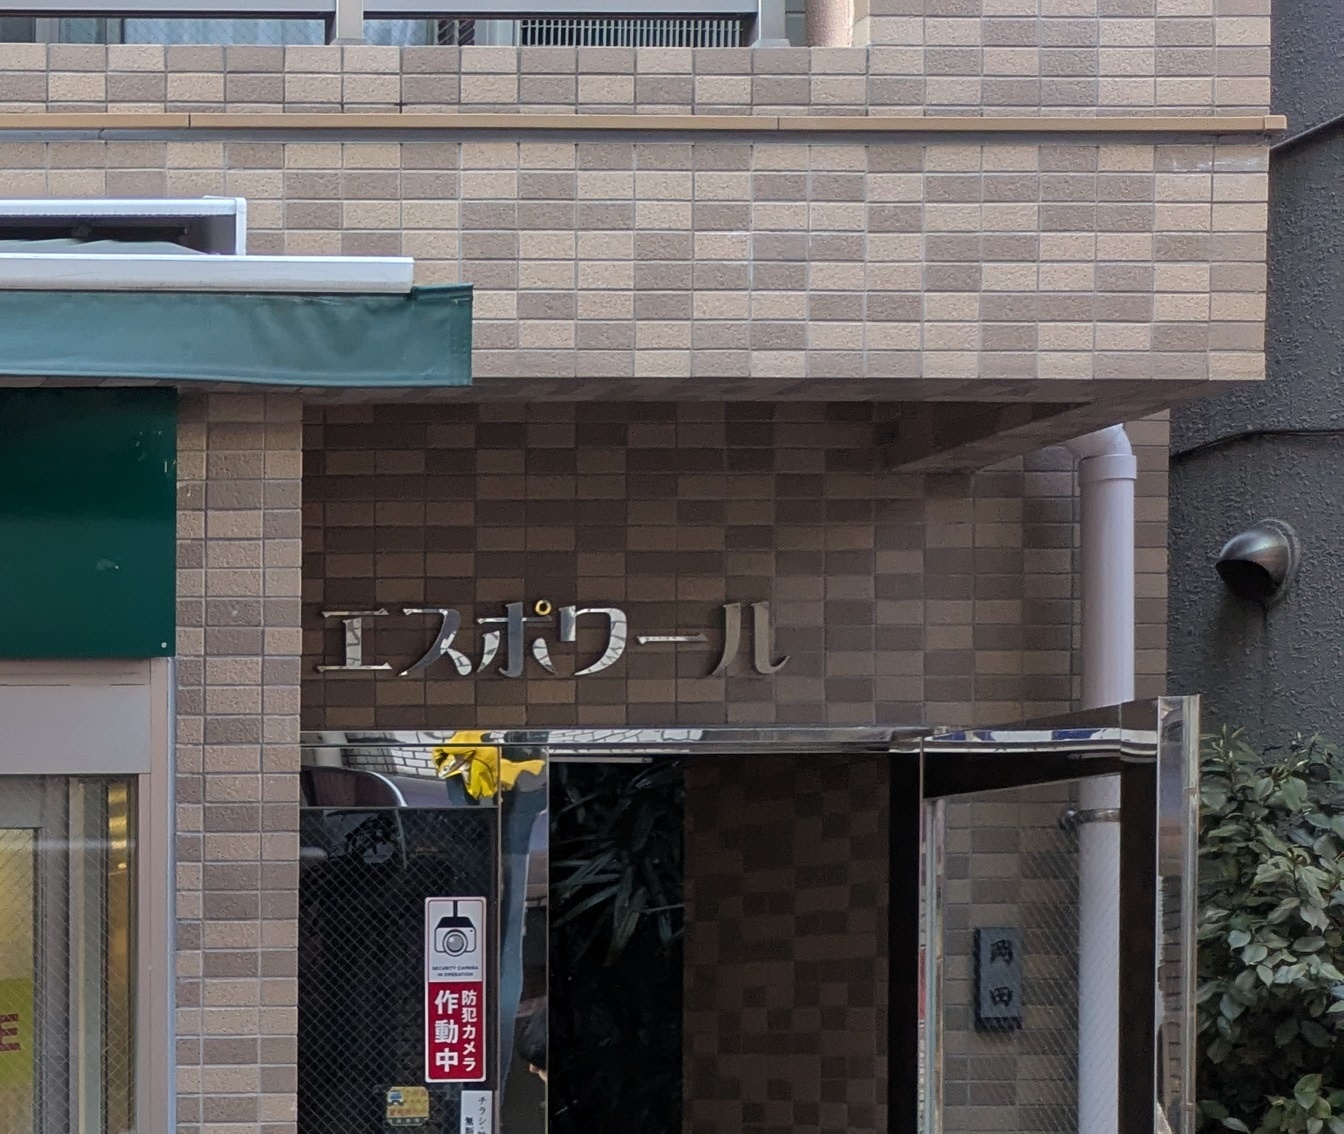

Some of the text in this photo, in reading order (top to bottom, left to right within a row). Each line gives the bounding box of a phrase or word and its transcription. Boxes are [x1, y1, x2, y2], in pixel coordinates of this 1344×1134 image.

[317, 599, 790, 678] エスポワール
[435, 990, 459, 1073] 作動中
[462, 990, 477, 1072] 防犯カメラ
